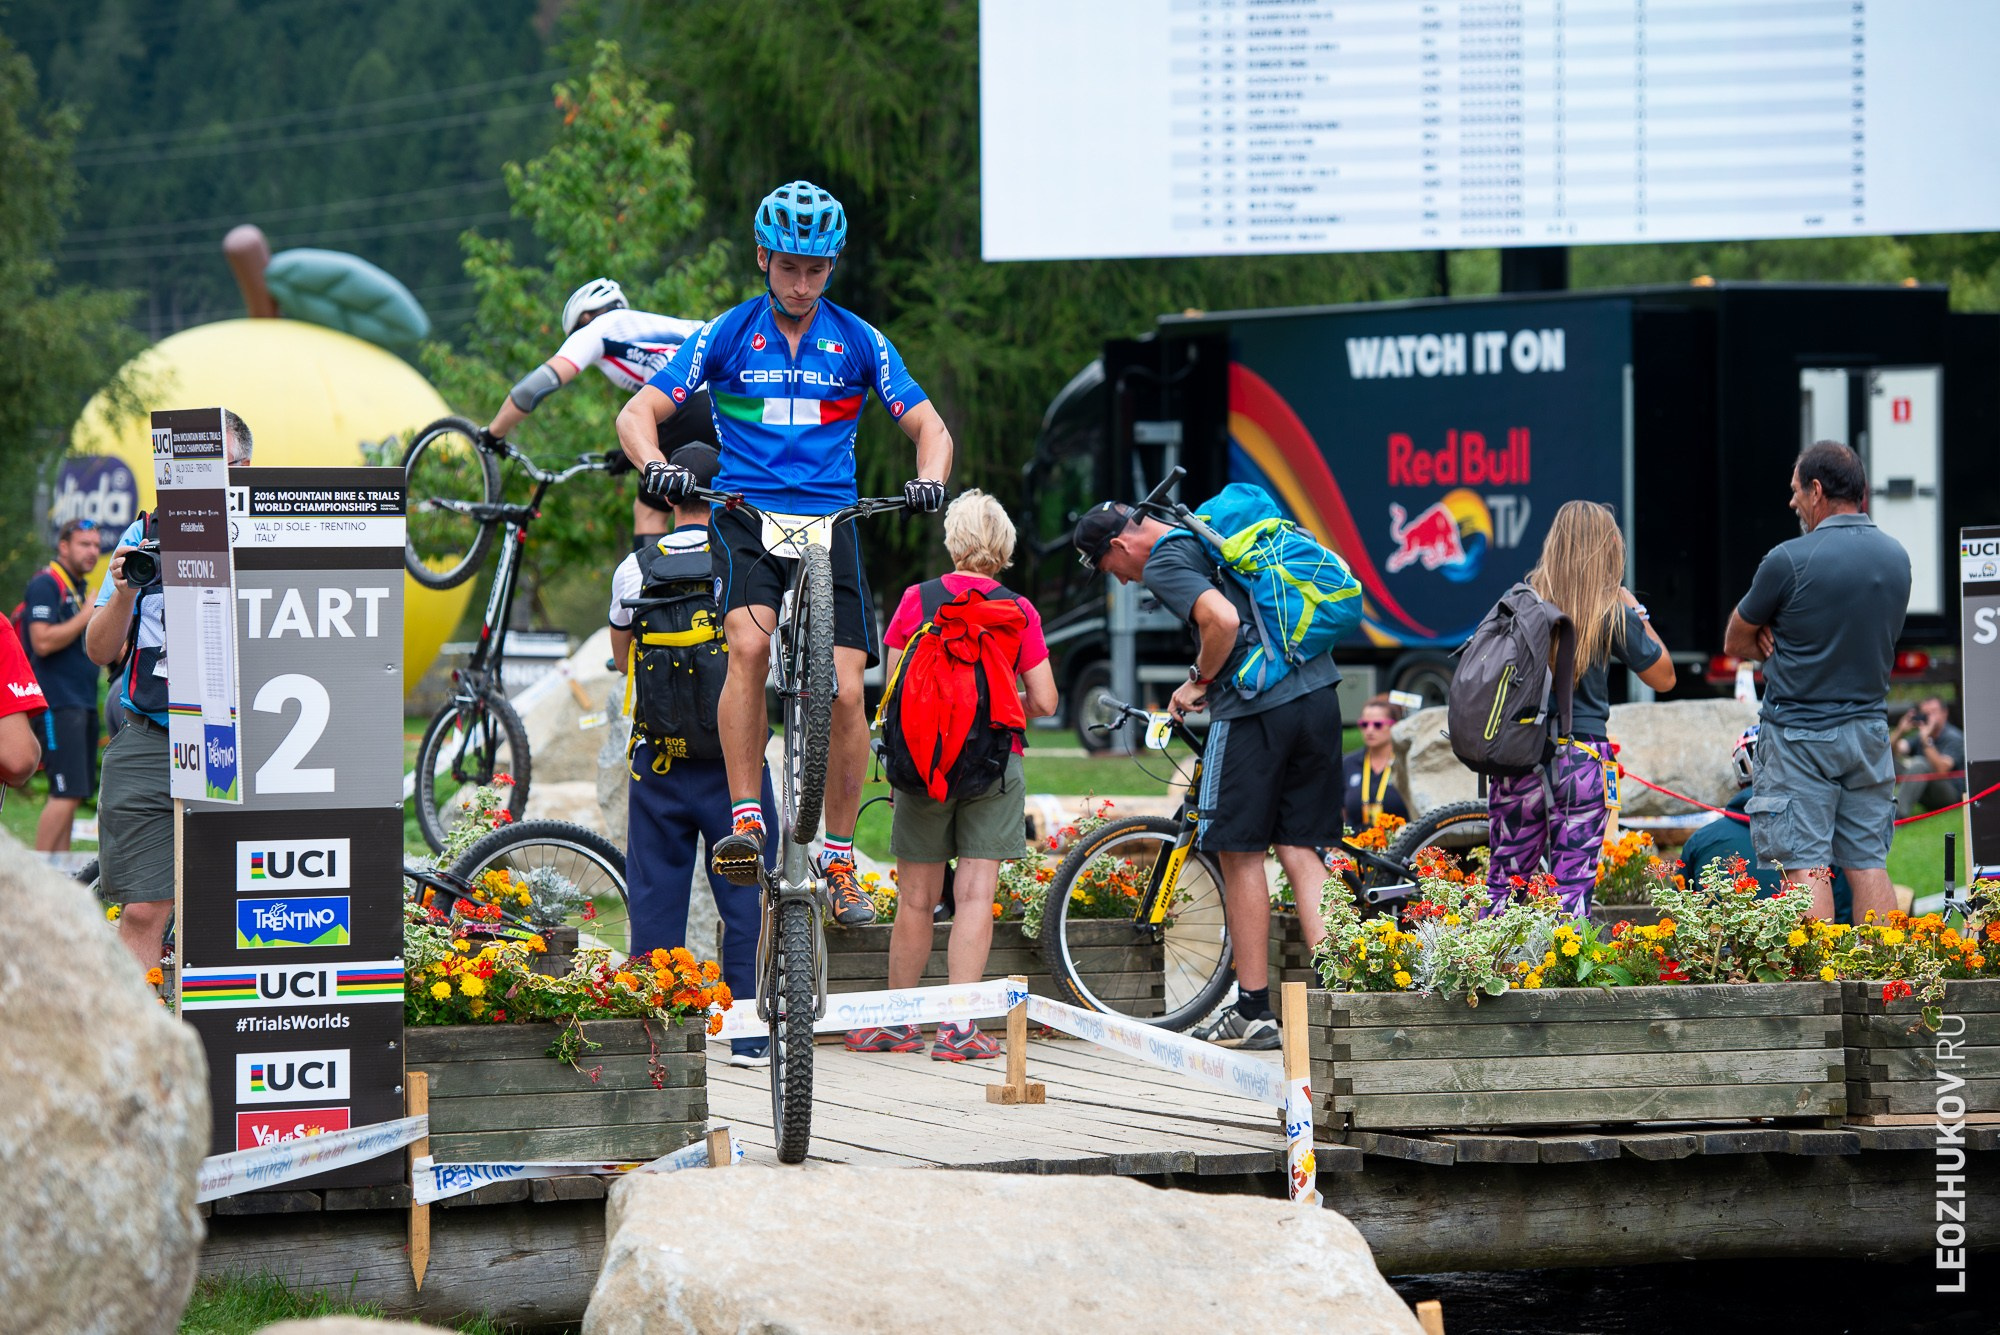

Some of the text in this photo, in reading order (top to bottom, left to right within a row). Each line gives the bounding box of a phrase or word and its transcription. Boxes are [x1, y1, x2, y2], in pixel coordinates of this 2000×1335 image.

[1346, 328, 1565, 379] WATCH IT ON
[156, 433, 171, 454] UCI
[254, 491, 400, 501] 2016 MOUNTAIN BIKE & TRIALS
[254, 502, 377, 512] WORLD CHAMPIONSHIPS
[254, 522, 271, 531] VAL
[273, 522, 283, 531] DI
[286, 522, 310, 531] SOLE
[320, 521, 367, 531] TRENTINO
[784, 528, 809, 545] 23
[254, 533, 277, 543] ITALY
[1969, 543, 2000, 557] UCI
[178, 560, 215, 579] SECTION 2
[238, 587, 390, 639] TART
[252, 673, 335, 794] 2
[664, 737, 687, 747] ROS
[179, 743, 200, 771] UCI
[207, 742, 234, 768] TRENTINO
[267, 850, 336, 879] UCI
[252, 907, 335, 931] TRENTINO
[260, 970, 327, 1000] UCI
[235, 1013, 350, 1033] #TrialsWorlds
[267, 1061, 336, 1091] UCI
